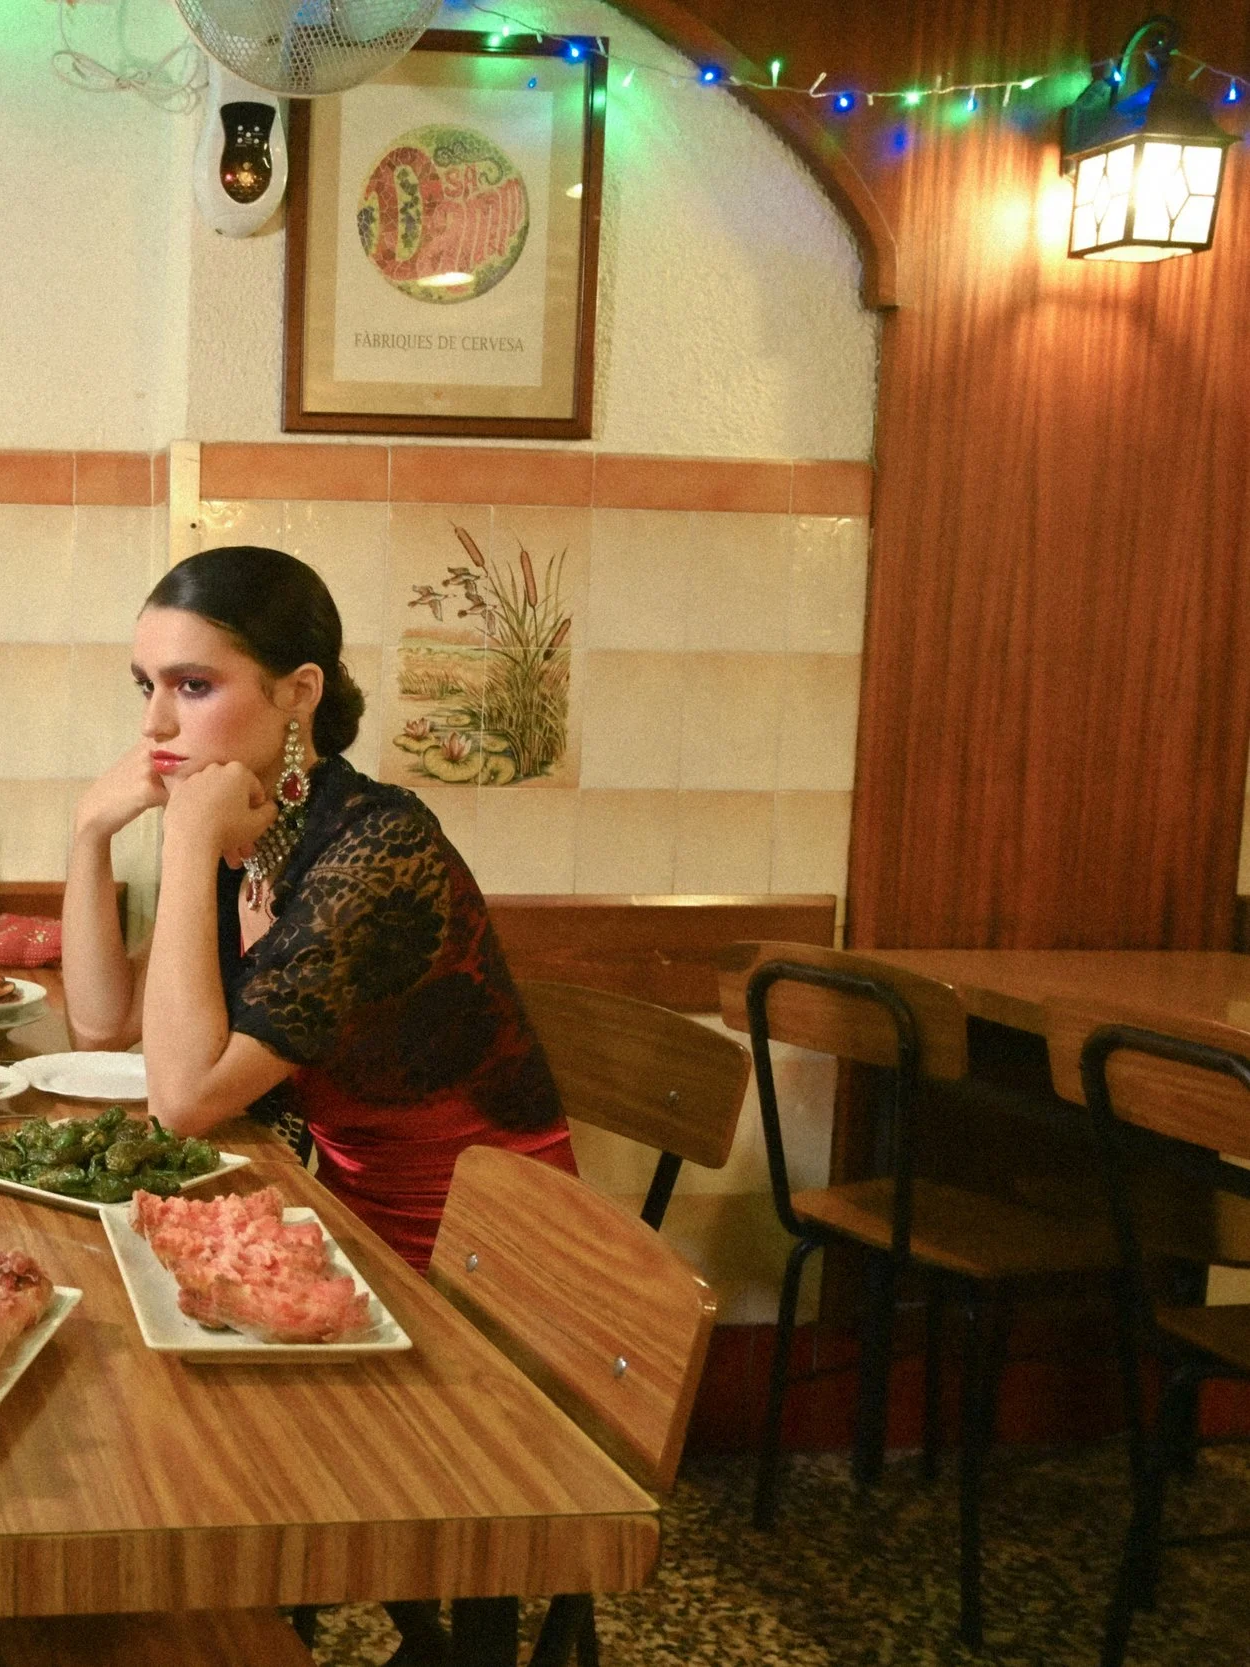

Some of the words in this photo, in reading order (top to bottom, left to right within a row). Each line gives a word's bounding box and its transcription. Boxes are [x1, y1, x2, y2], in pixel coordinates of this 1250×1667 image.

[355, 331, 433, 351] FÀBRIQUES
[438, 335, 456, 350] DE
[461, 336, 524, 352] CERVESA
